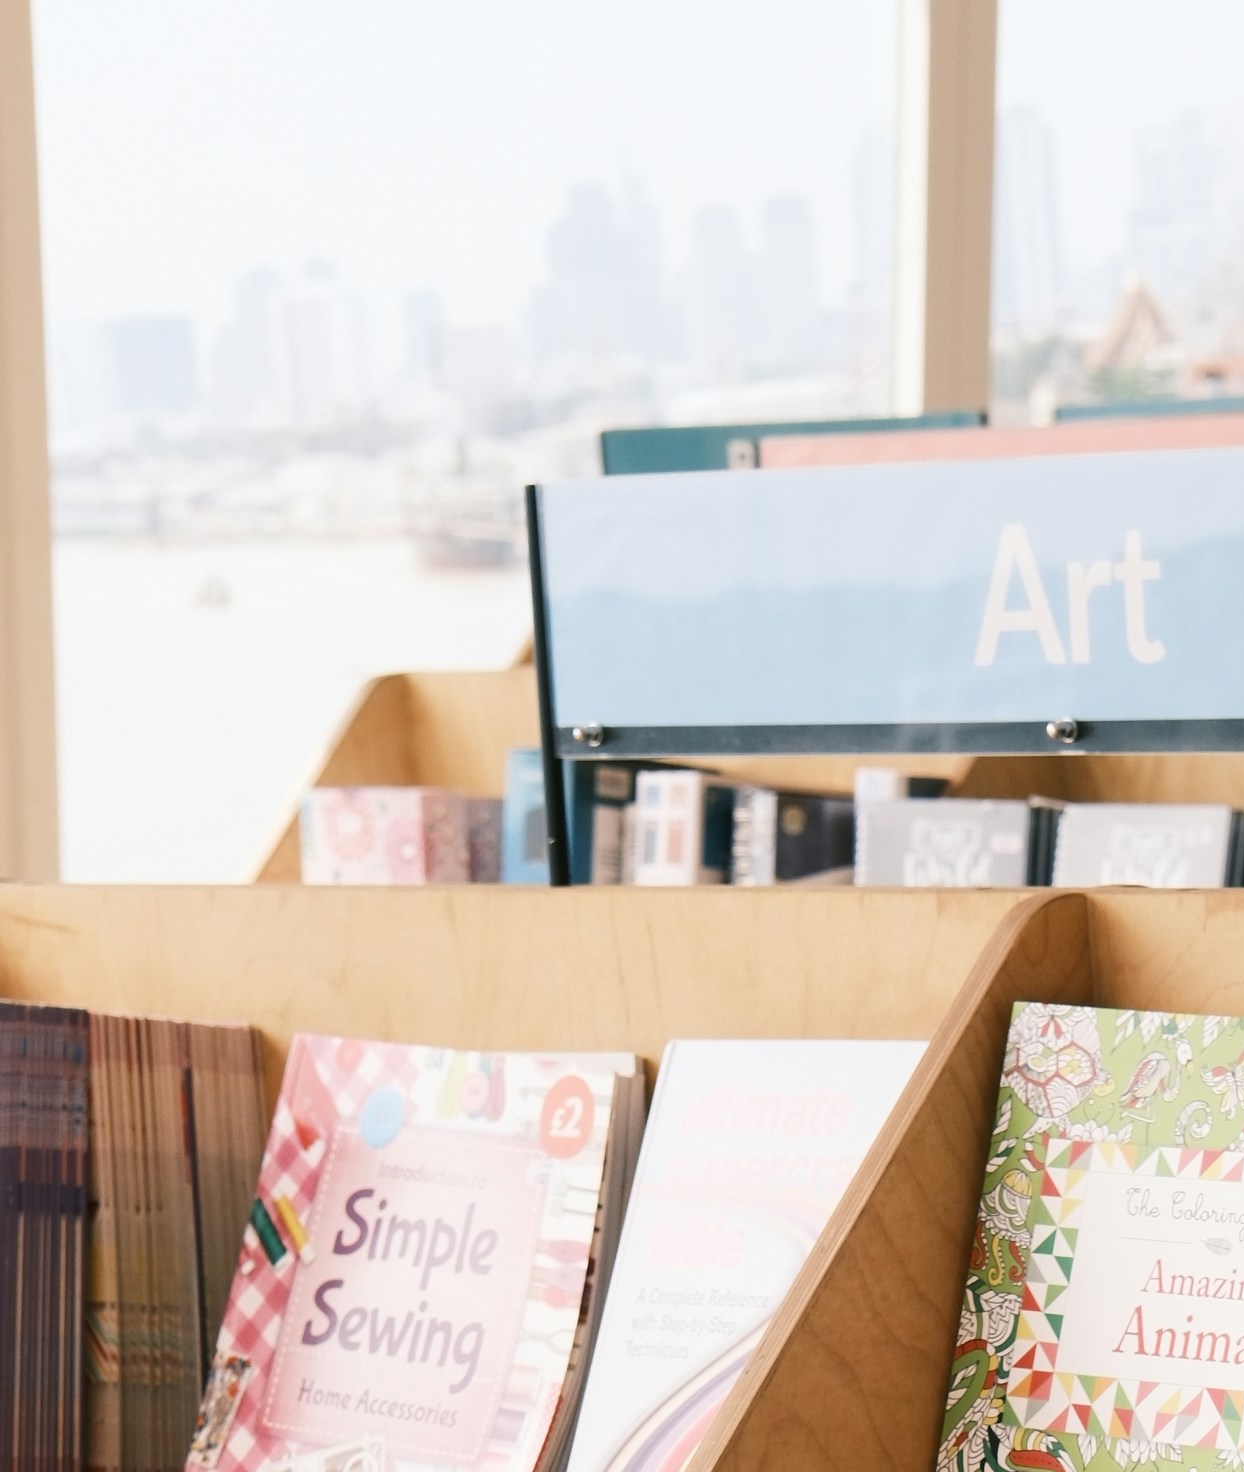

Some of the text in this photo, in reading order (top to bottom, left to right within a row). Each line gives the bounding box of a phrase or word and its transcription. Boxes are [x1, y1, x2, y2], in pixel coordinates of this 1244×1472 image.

[974, 523, 1166, 666] Art
[549, 1095, 583, 1138] £2
[378, 1161, 487, 1190] Introduction to
[1126, 1187, 1160, 1218] The
[332, 1188, 498, 1290] Simple
[301, 1279, 485, 1394] Sewing
[298, 1378, 458, 1428] Home Accessories
